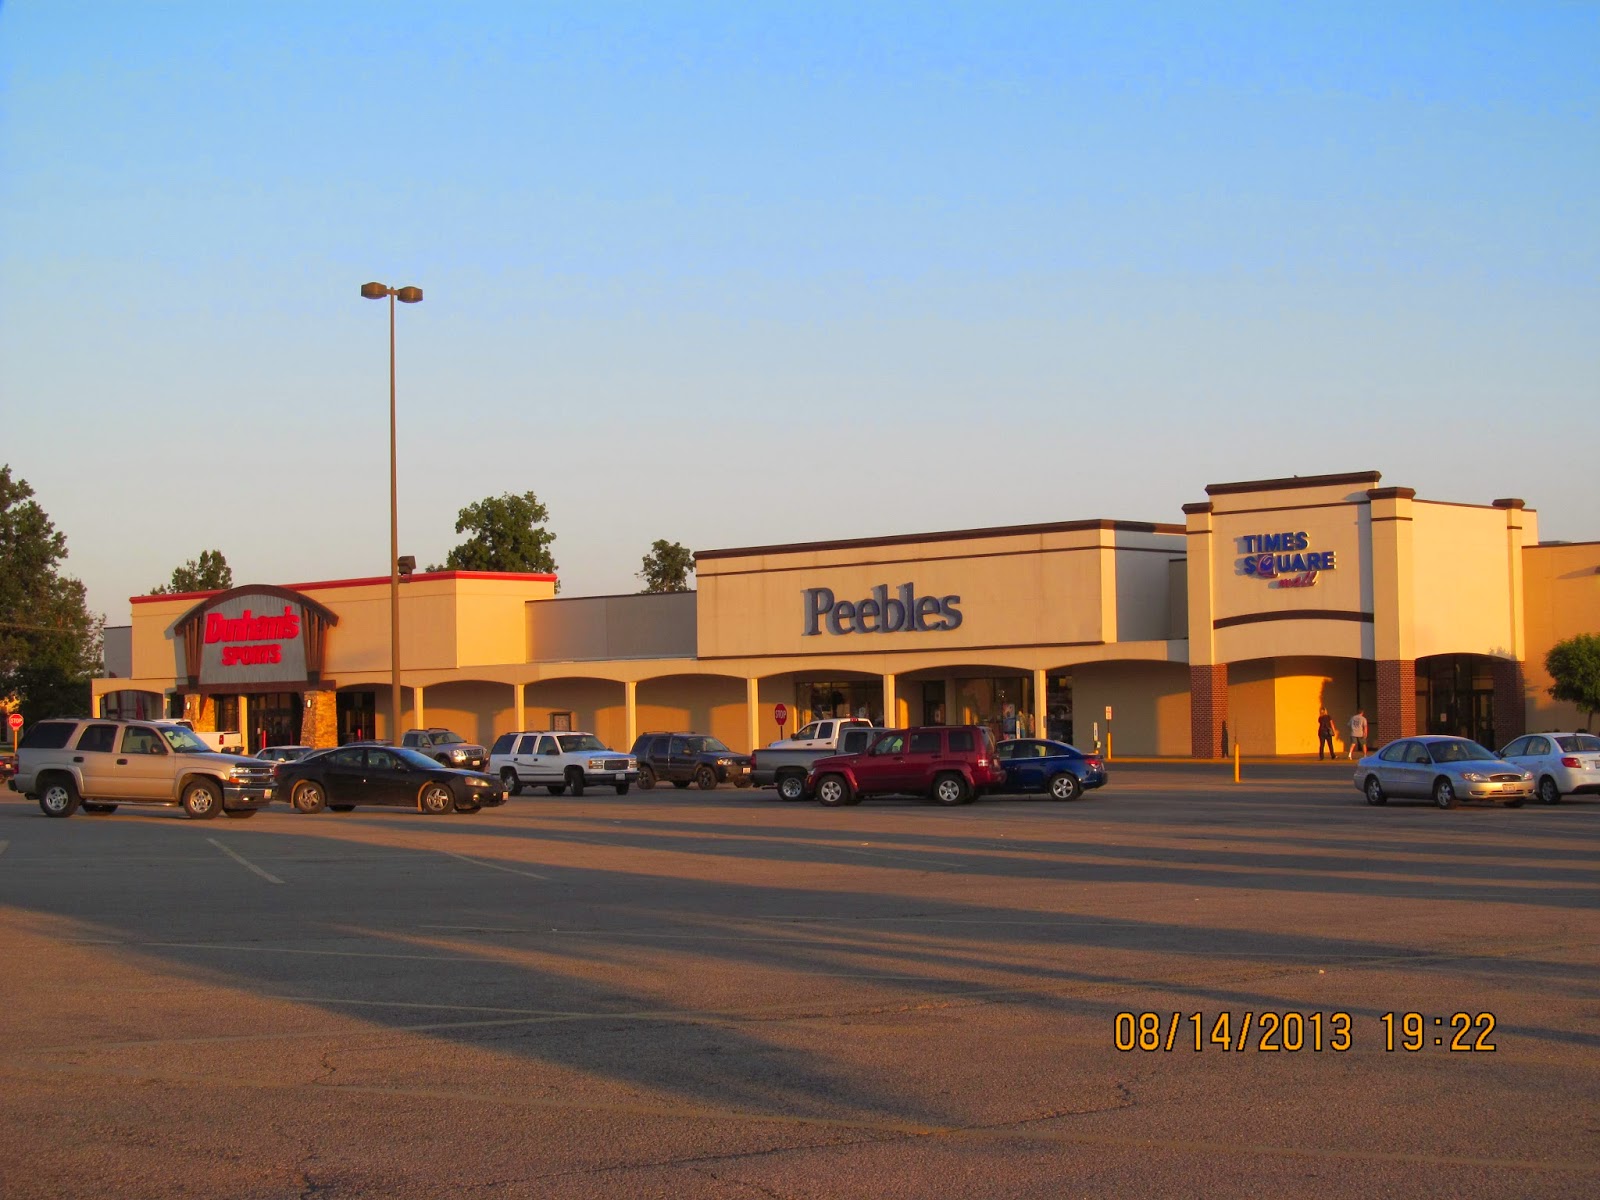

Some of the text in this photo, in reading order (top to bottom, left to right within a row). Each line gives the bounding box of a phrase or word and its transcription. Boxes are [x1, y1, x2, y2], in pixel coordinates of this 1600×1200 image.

[1243, 531, 1308, 553] TIMES
[1244, 551, 1335, 578] SQUARE
[802, 582, 963, 636] Peebles
[205, 606, 299, 644] Dunham's
[222, 644, 282, 666] SPORTS
[775, 709, 786, 718] STOP
